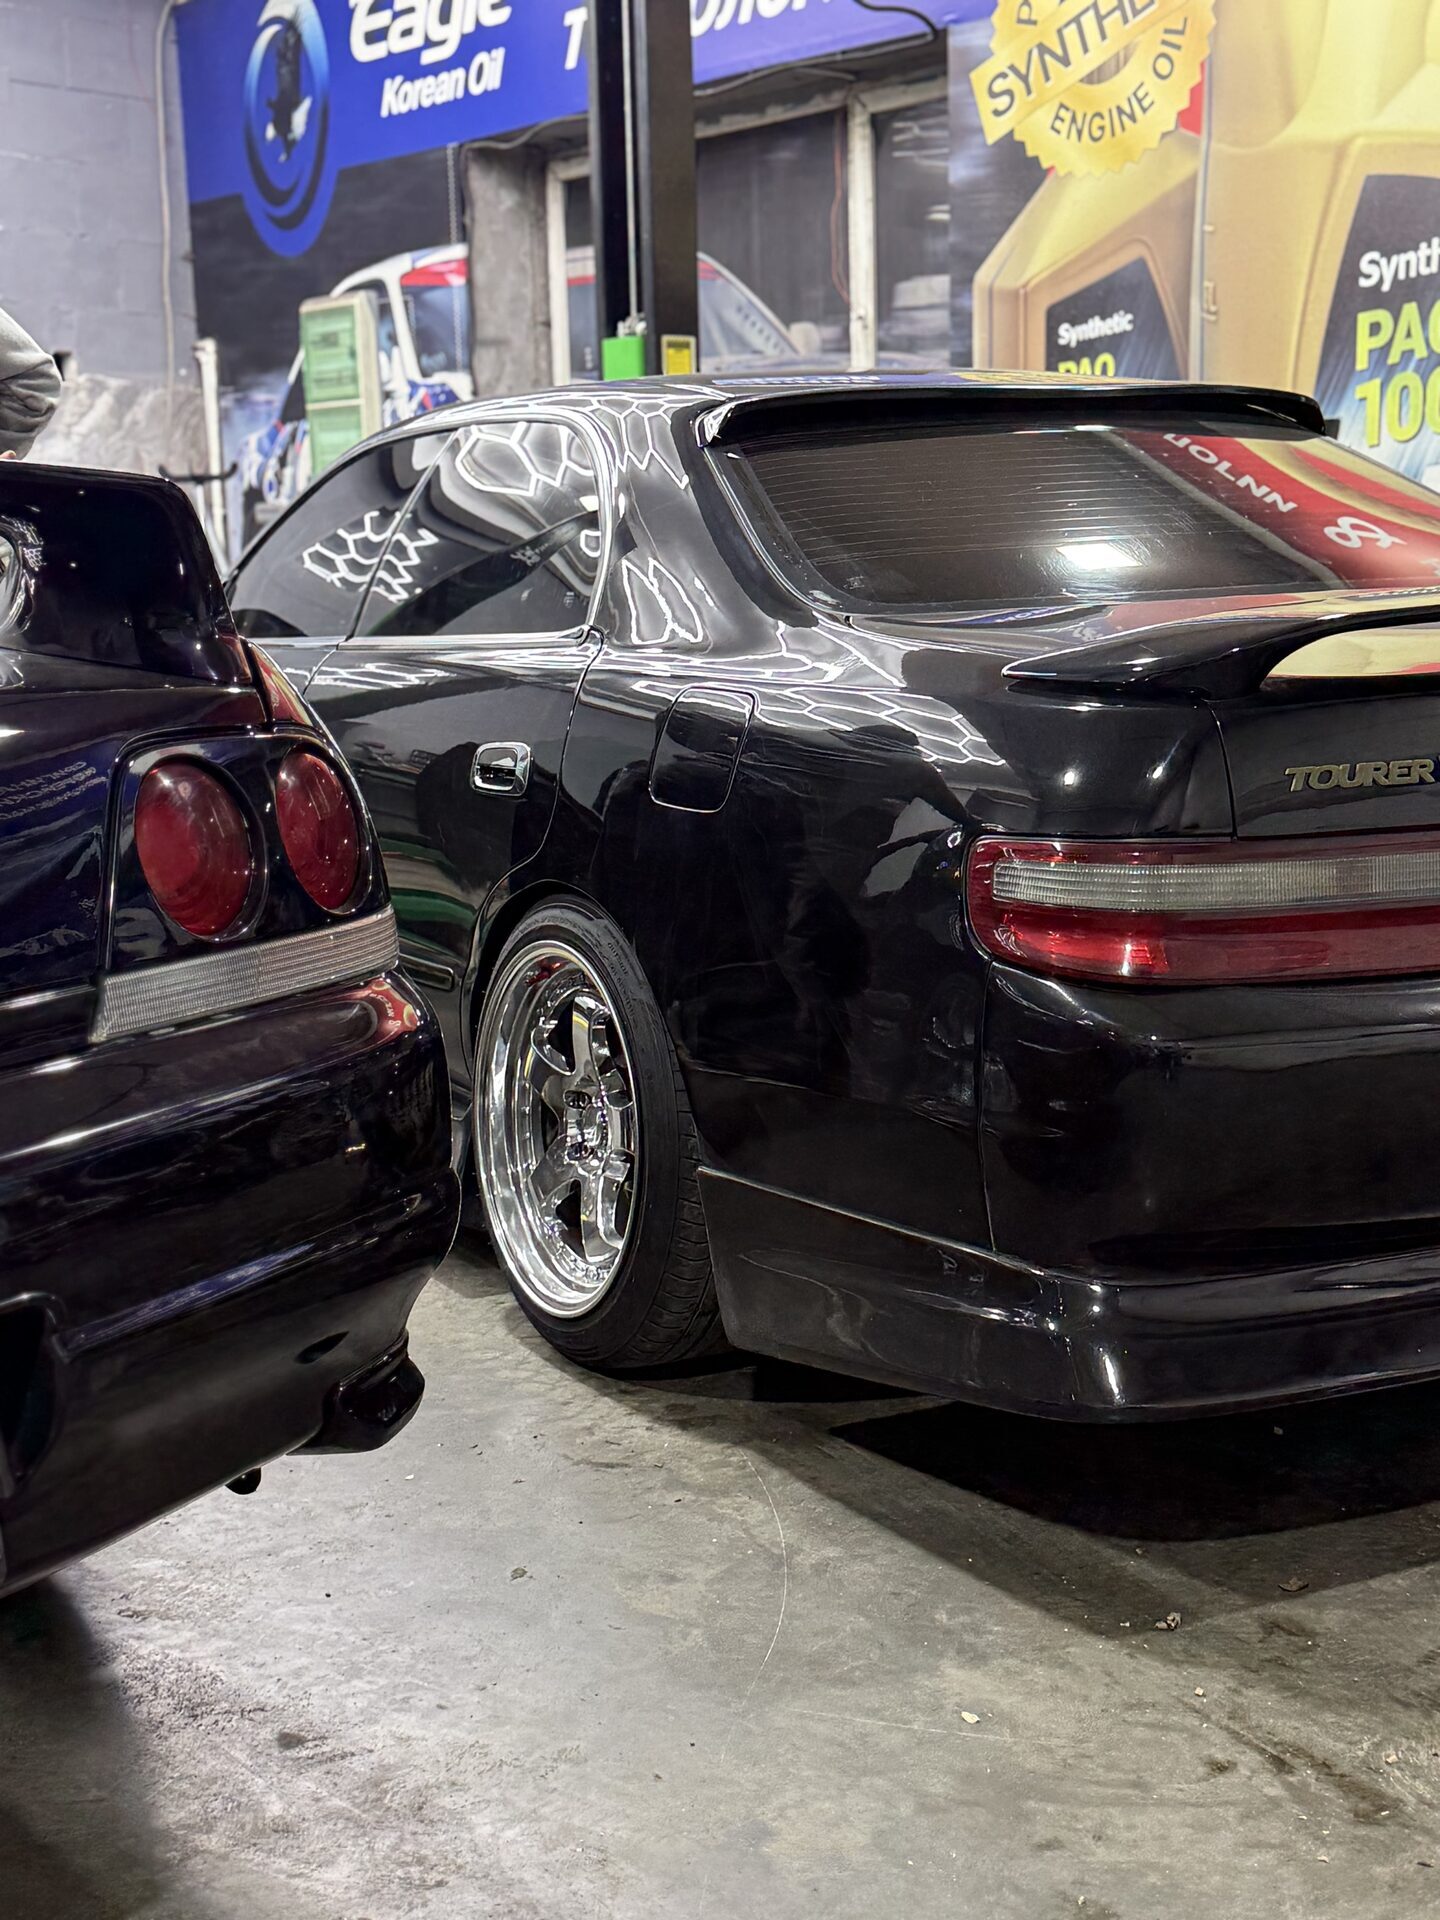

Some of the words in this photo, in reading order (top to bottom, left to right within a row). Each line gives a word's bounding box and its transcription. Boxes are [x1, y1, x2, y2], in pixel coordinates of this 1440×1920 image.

[380, 67, 466, 118] Korean
[468, 46, 506, 96] Oil
[1050, 81, 1155, 143] ENGINE
[1152, 16, 1188, 80] OIL
[1058, 310, 1134, 348] Synthetic
[1284, 758, 1435, 793] TOURER
